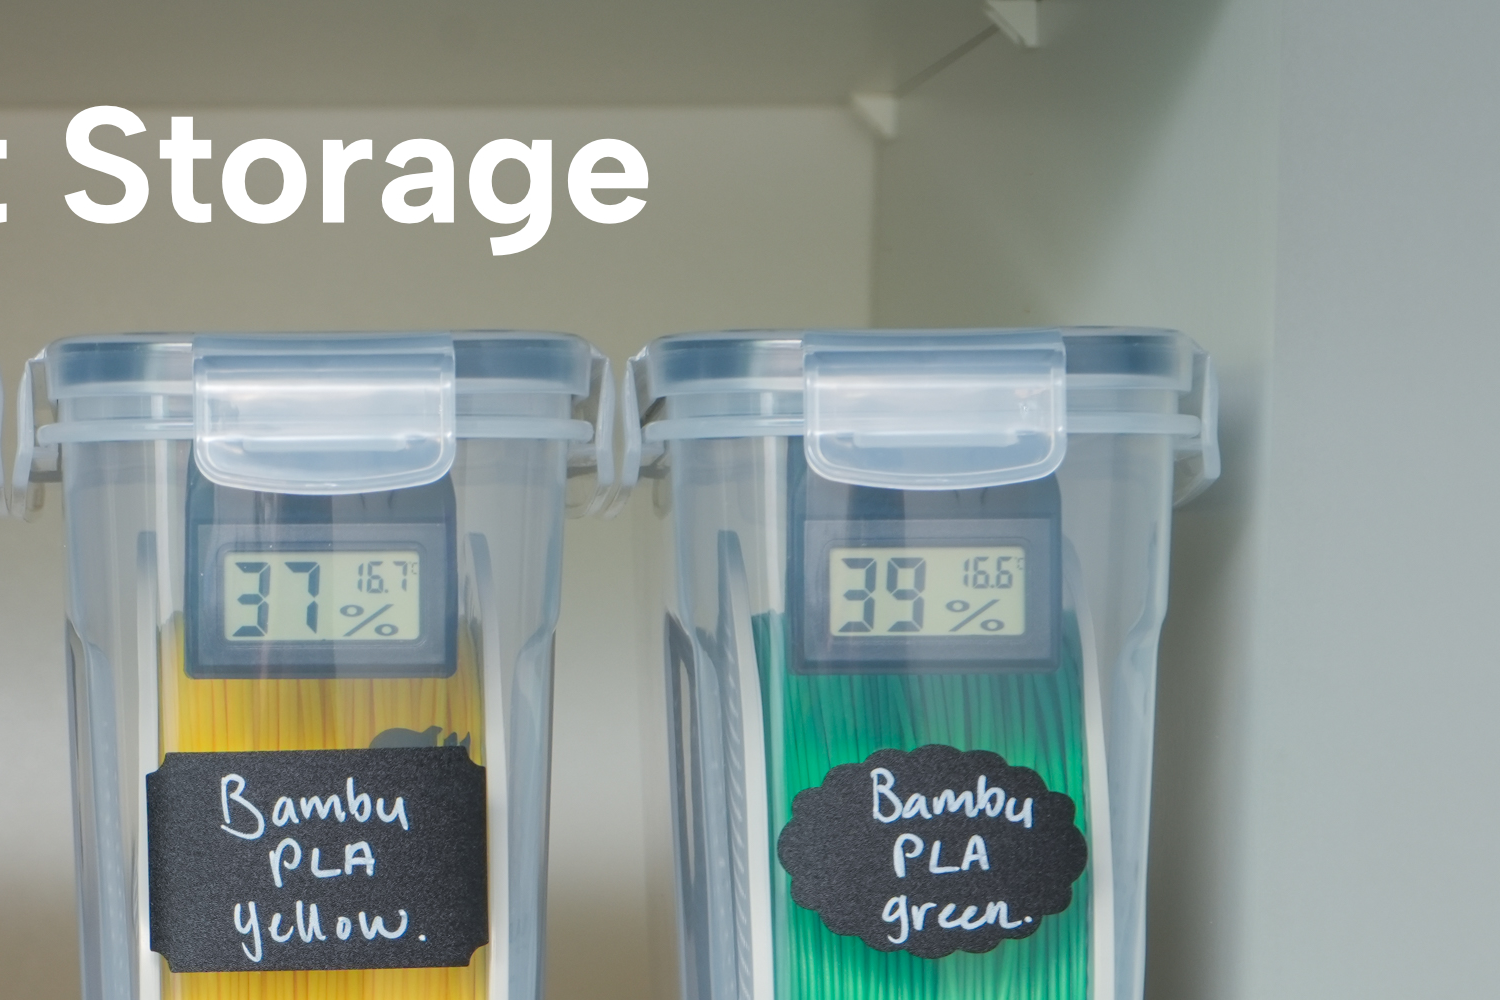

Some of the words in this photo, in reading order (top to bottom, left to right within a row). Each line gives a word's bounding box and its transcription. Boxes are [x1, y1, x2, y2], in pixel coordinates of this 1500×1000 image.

[221, 774, 409, 840] Bambu
[871, 768, 1033, 828] Bambu
[269, 838, 376, 888] PLA
[893, 833, 990, 878] PLA
[882, 895, 1033, 944] green.
